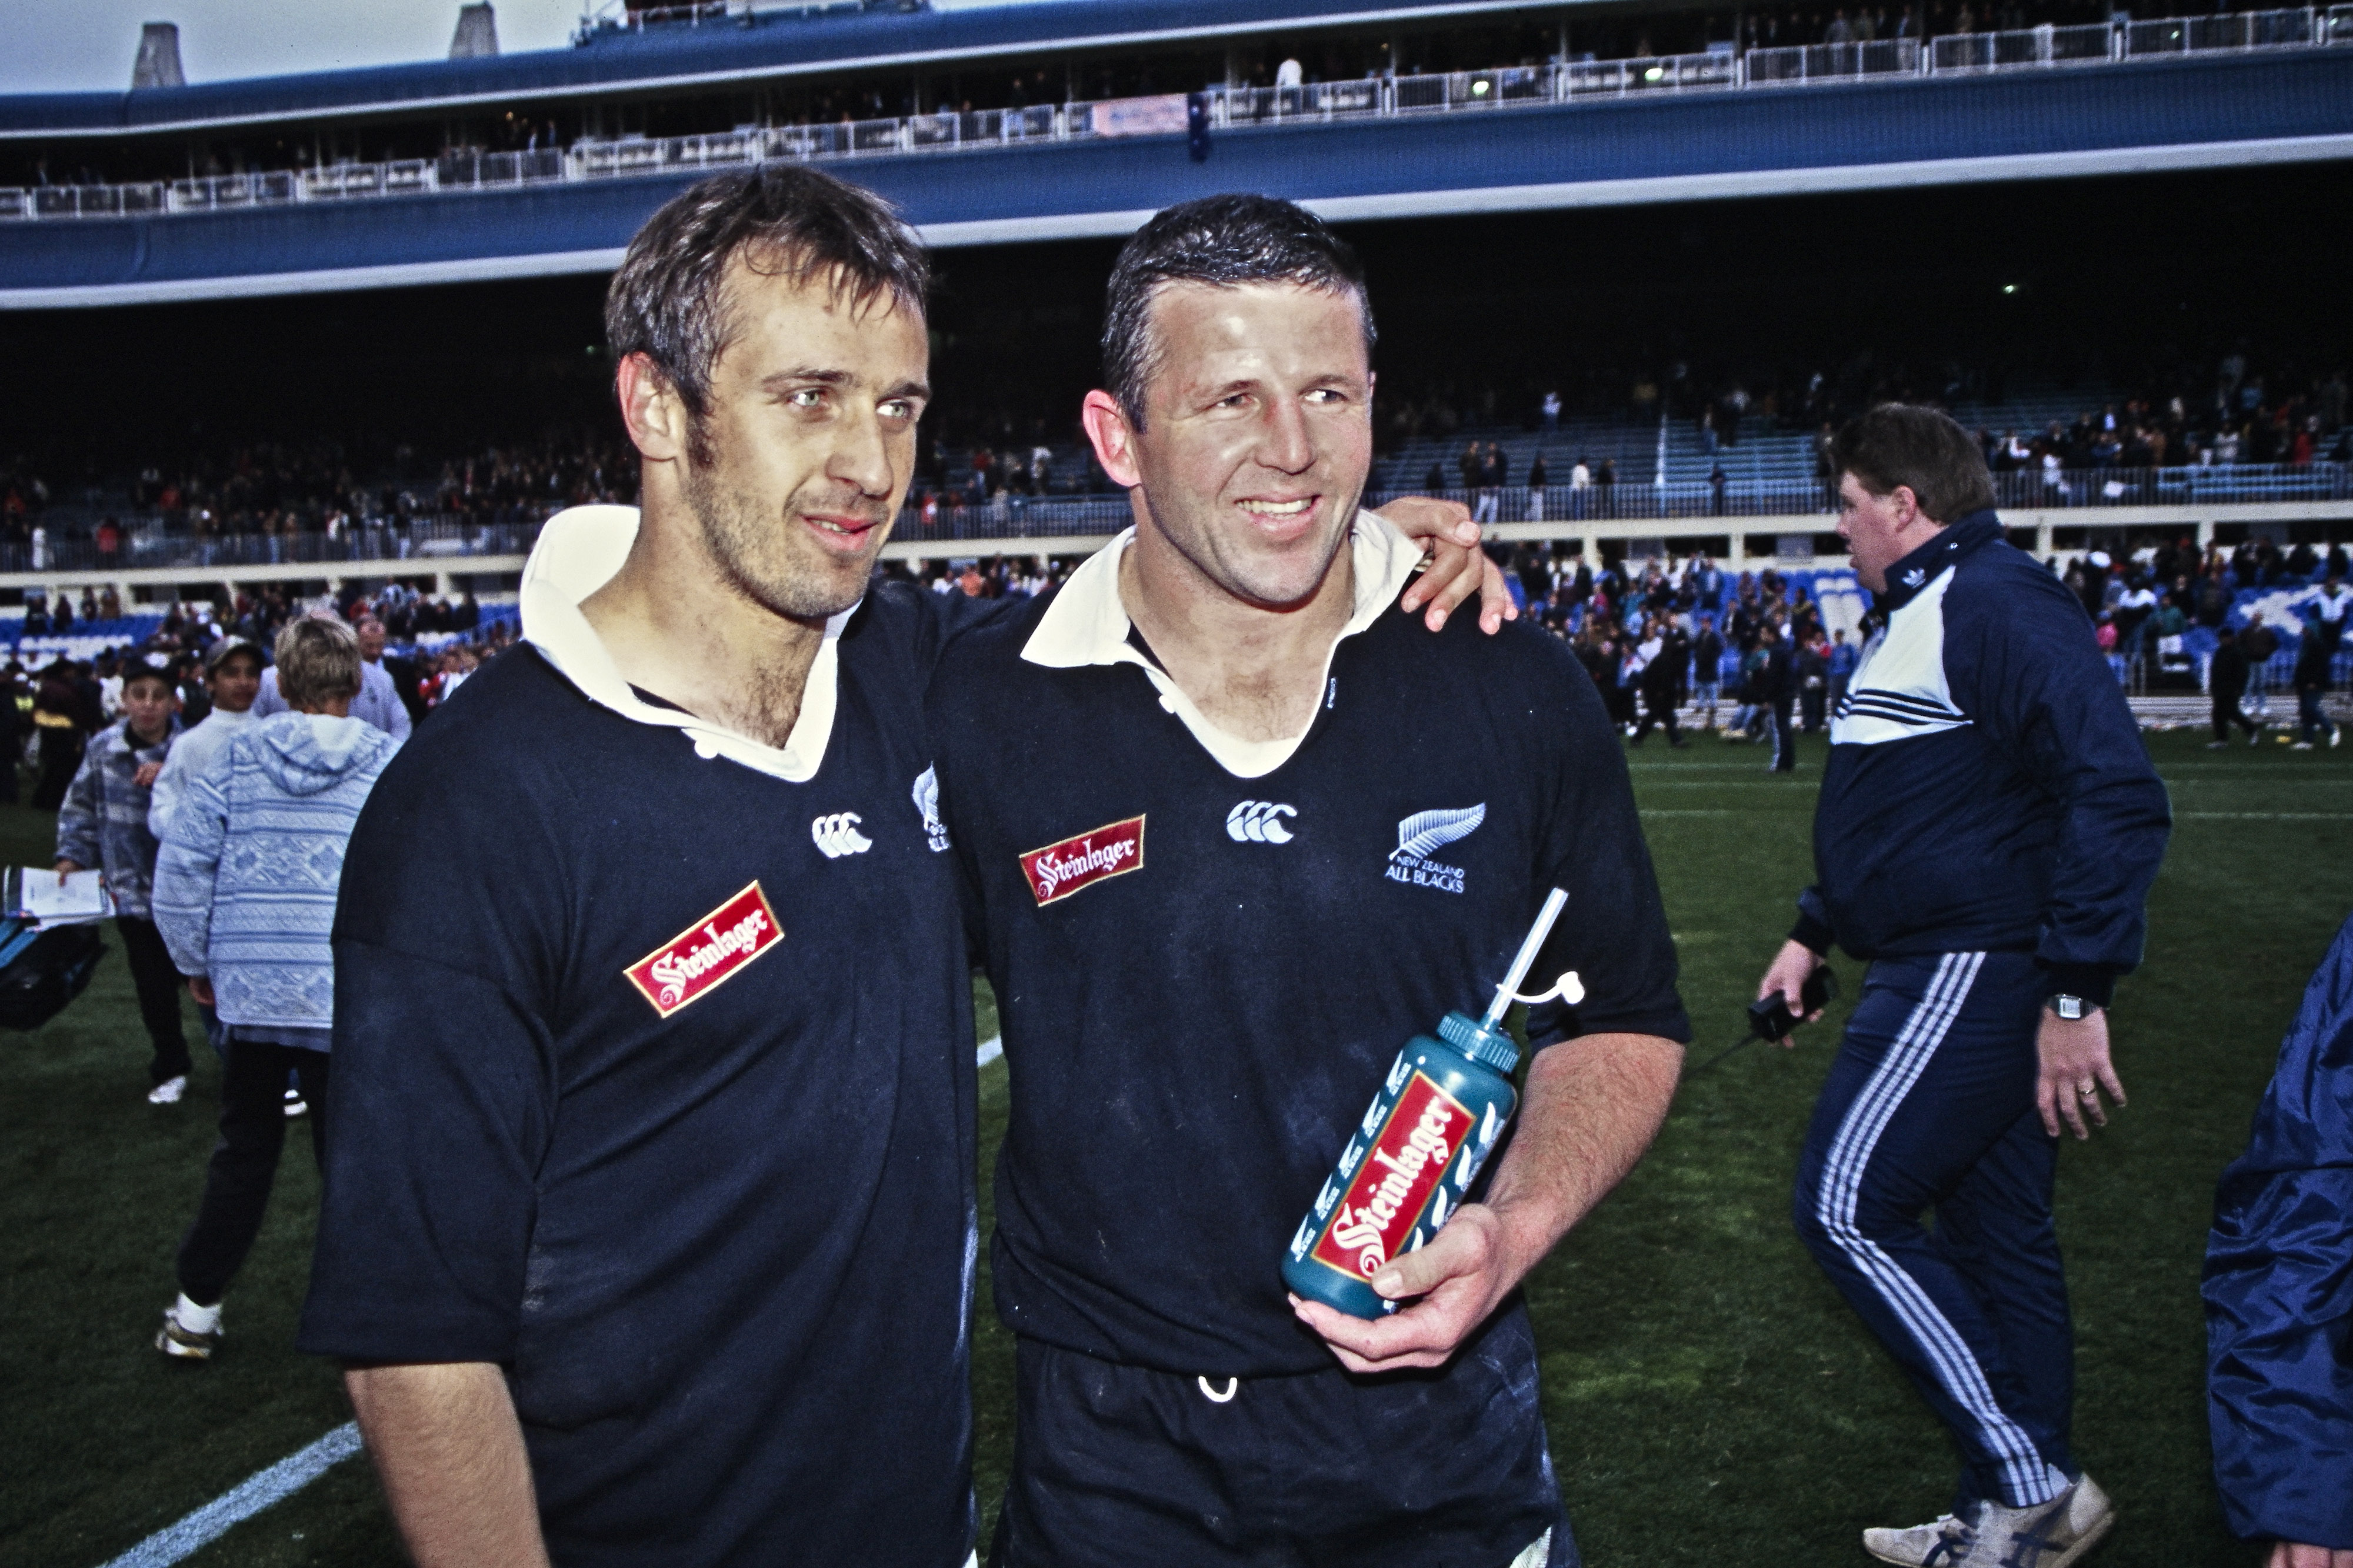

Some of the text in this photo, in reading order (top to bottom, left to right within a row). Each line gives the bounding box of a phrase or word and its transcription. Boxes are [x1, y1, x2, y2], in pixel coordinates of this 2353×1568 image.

[1036, 838, 1135, 898] Steinlager
[1385, 865, 1464, 893] ALL BLACKS
[1397, 855, 1465, 879] NEW ZEALAND
[651, 909, 768, 1006] Steinlager
[1332, 1095, 1452, 1277] Steinlager
